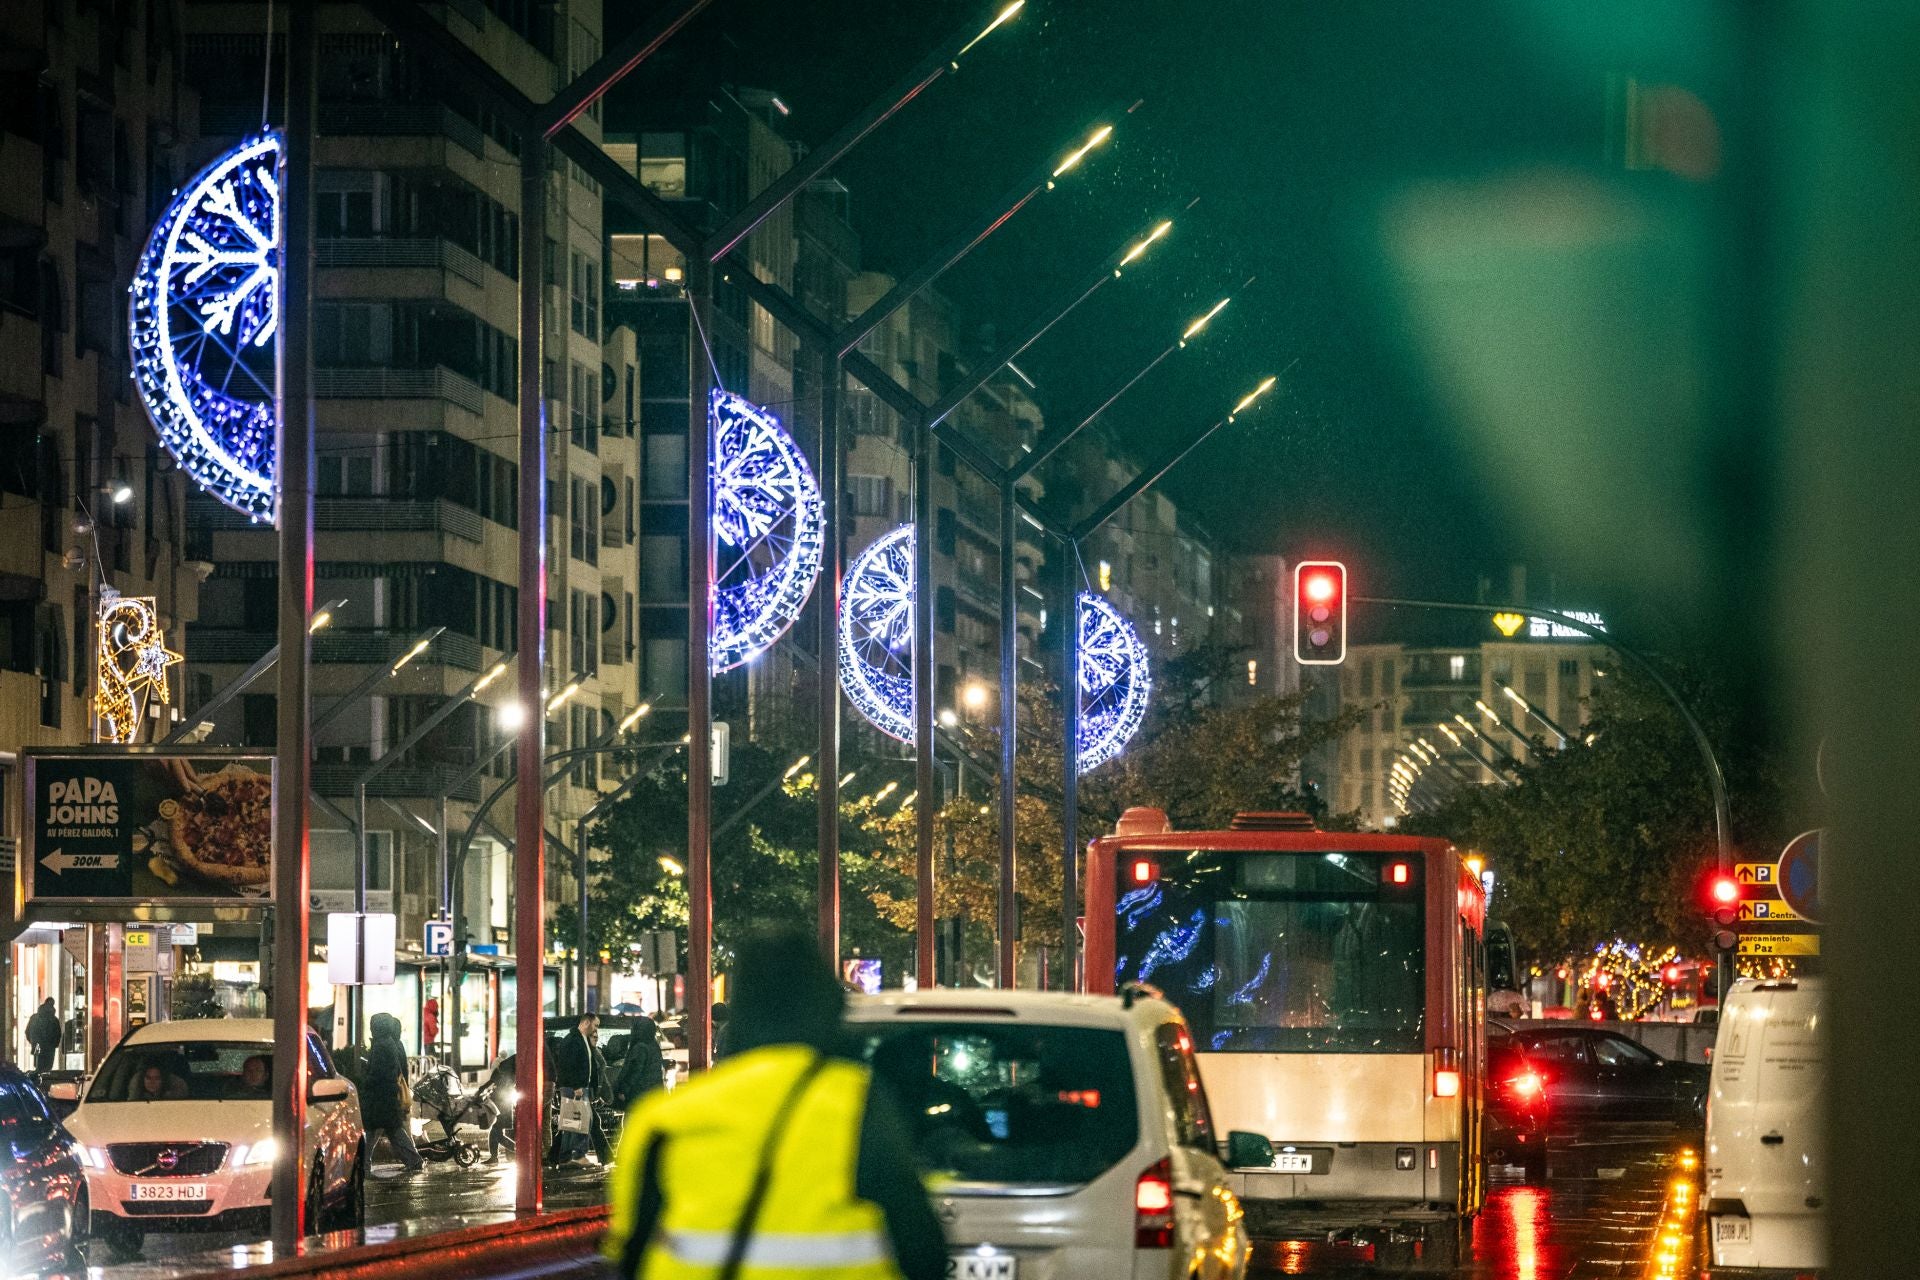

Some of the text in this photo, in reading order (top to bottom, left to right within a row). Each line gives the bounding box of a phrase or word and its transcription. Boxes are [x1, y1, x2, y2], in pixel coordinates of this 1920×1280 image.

[49, 777, 118, 804] PAPA
[46, 805, 119, 824] JOHNS
[47, 826, 119, 839] AV PÉREZ GALDÓS, 1
[1757, 867, 1768, 881] P
[1755, 904, 1767, 917] P
[431, 926, 452, 953] P
[1754, 943, 1773, 953] Paz
[1282, 1156, 1308, 1168] FFW
[140, 1186, 174, 1198] 3823
